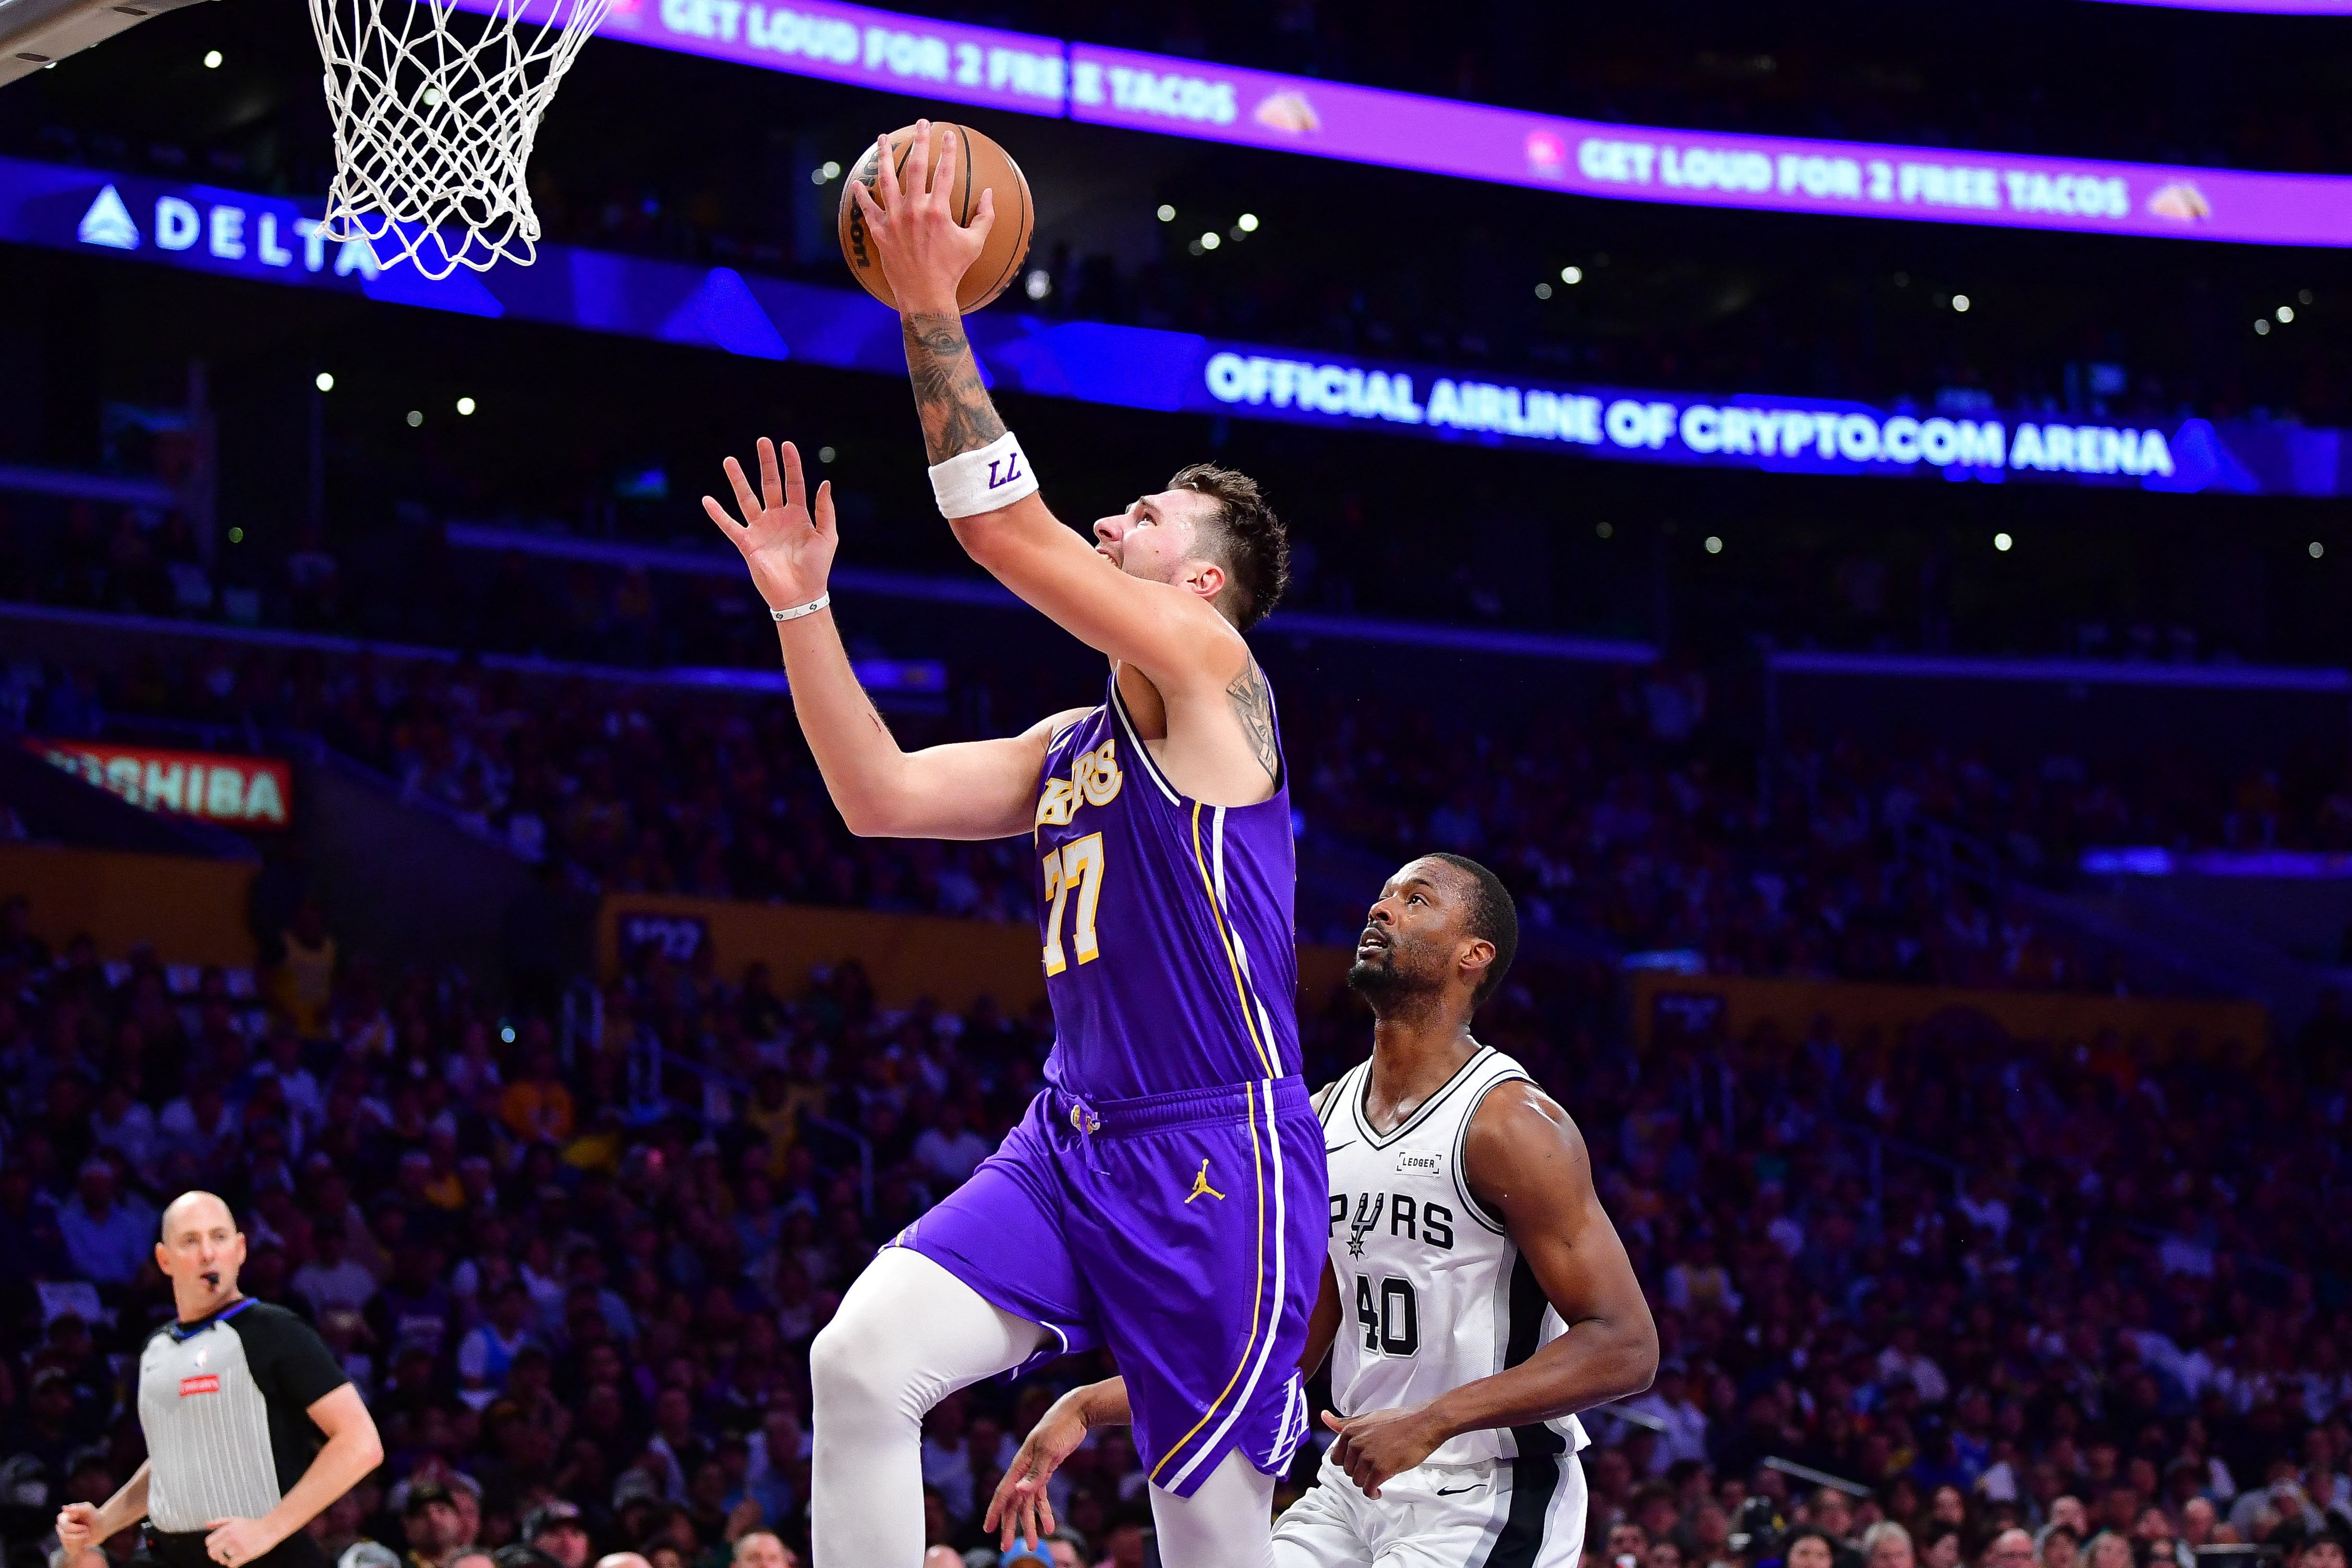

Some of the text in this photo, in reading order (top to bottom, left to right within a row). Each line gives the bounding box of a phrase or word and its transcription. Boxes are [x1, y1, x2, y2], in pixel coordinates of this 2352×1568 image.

[660, 0, 742, 42] GET
[746, 4, 861, 64] LOUD
[863, 26, 950, 82] FOR
[954, 42, 984, 88] 2
[1106, 66, 1238, 126] TACOS
[1578, 138, 2130, 219] GET LOUD FOR 2 FREE TACOS
[155, 196, 380, 281] DELTA
[1206, 354, 2174, 475] OFFICIAL AIRLINE OF CRYPTO.COM ARENA
[1043, 832, 1105, 977] 77
[1402, 1157, 1435, 1168] LEDGER
[1329, 1192, 1454, 1262] PURS
[1356, 1271, 1422, 1359] 40
